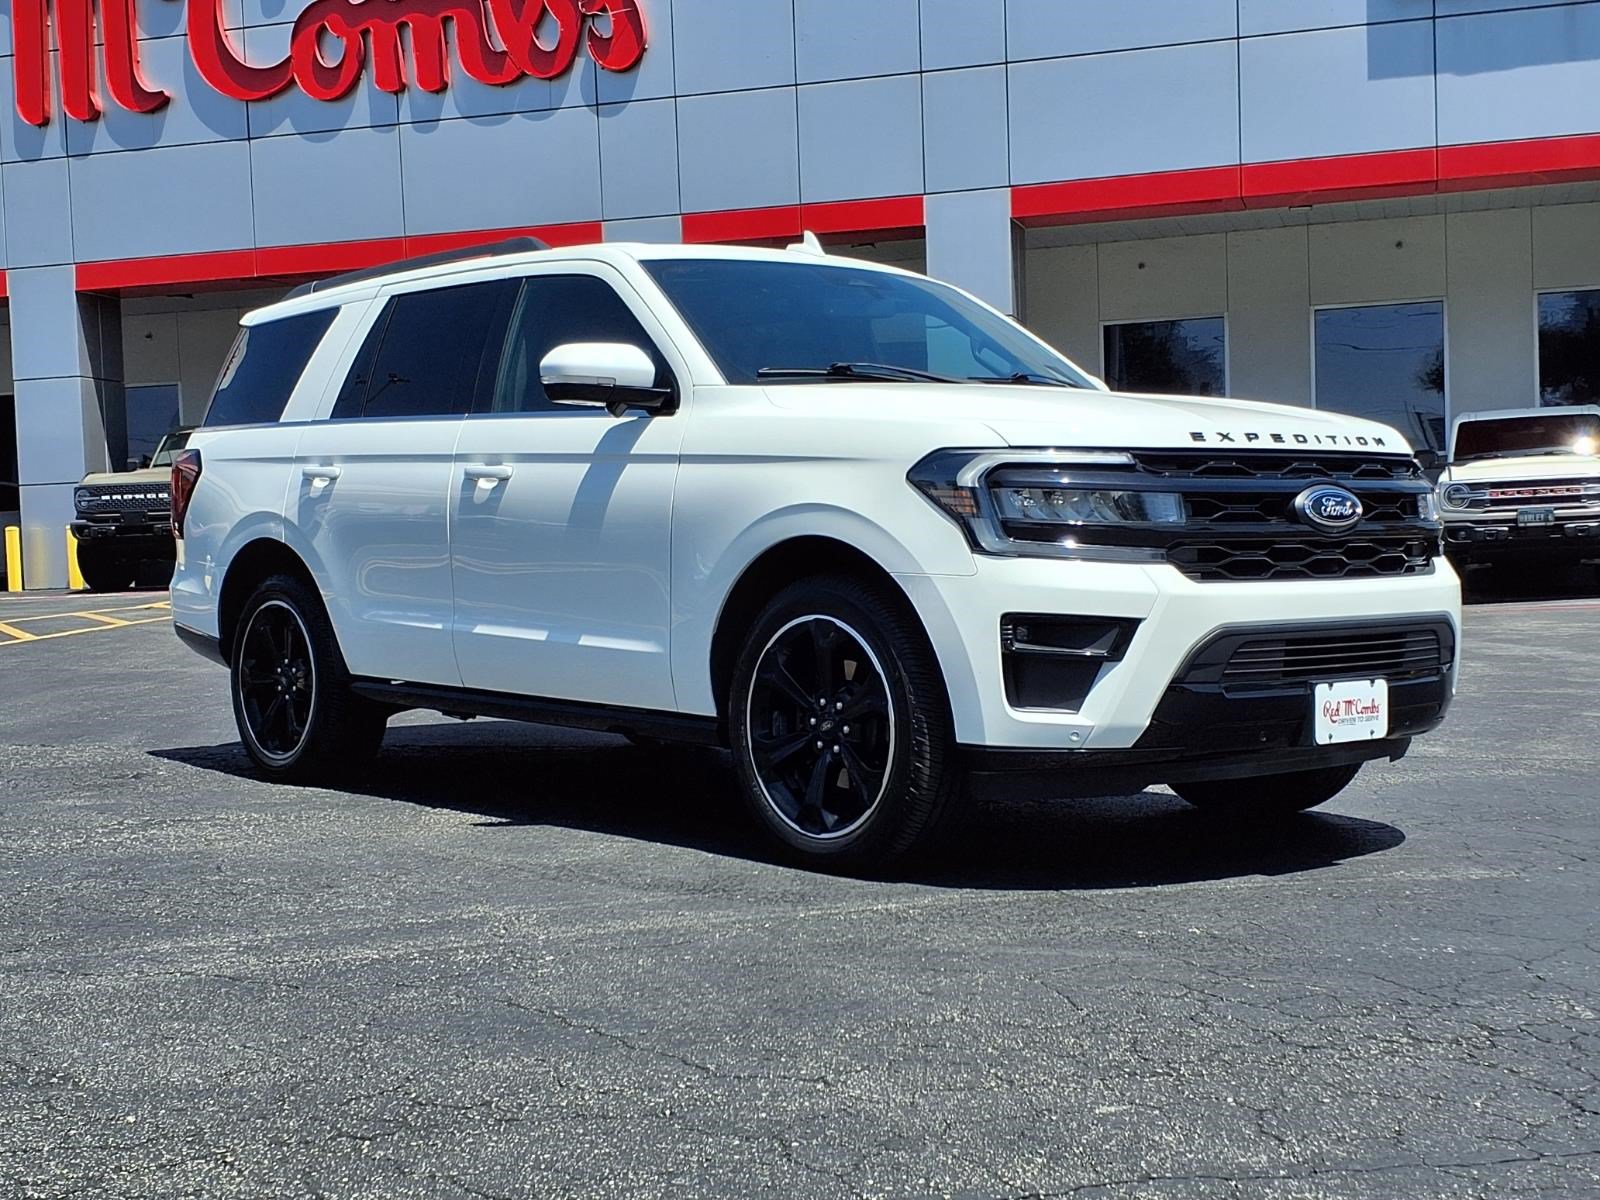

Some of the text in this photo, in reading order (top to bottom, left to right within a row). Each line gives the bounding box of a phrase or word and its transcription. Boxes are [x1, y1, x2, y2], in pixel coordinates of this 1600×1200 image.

[1189, 431, 1386, 447] EXPEDITION
[101, 493, 168, 501] BRONCO
[1320, 496, 1354, 517] Ford
[1323, 698, 1380, 724] Red McCombs
